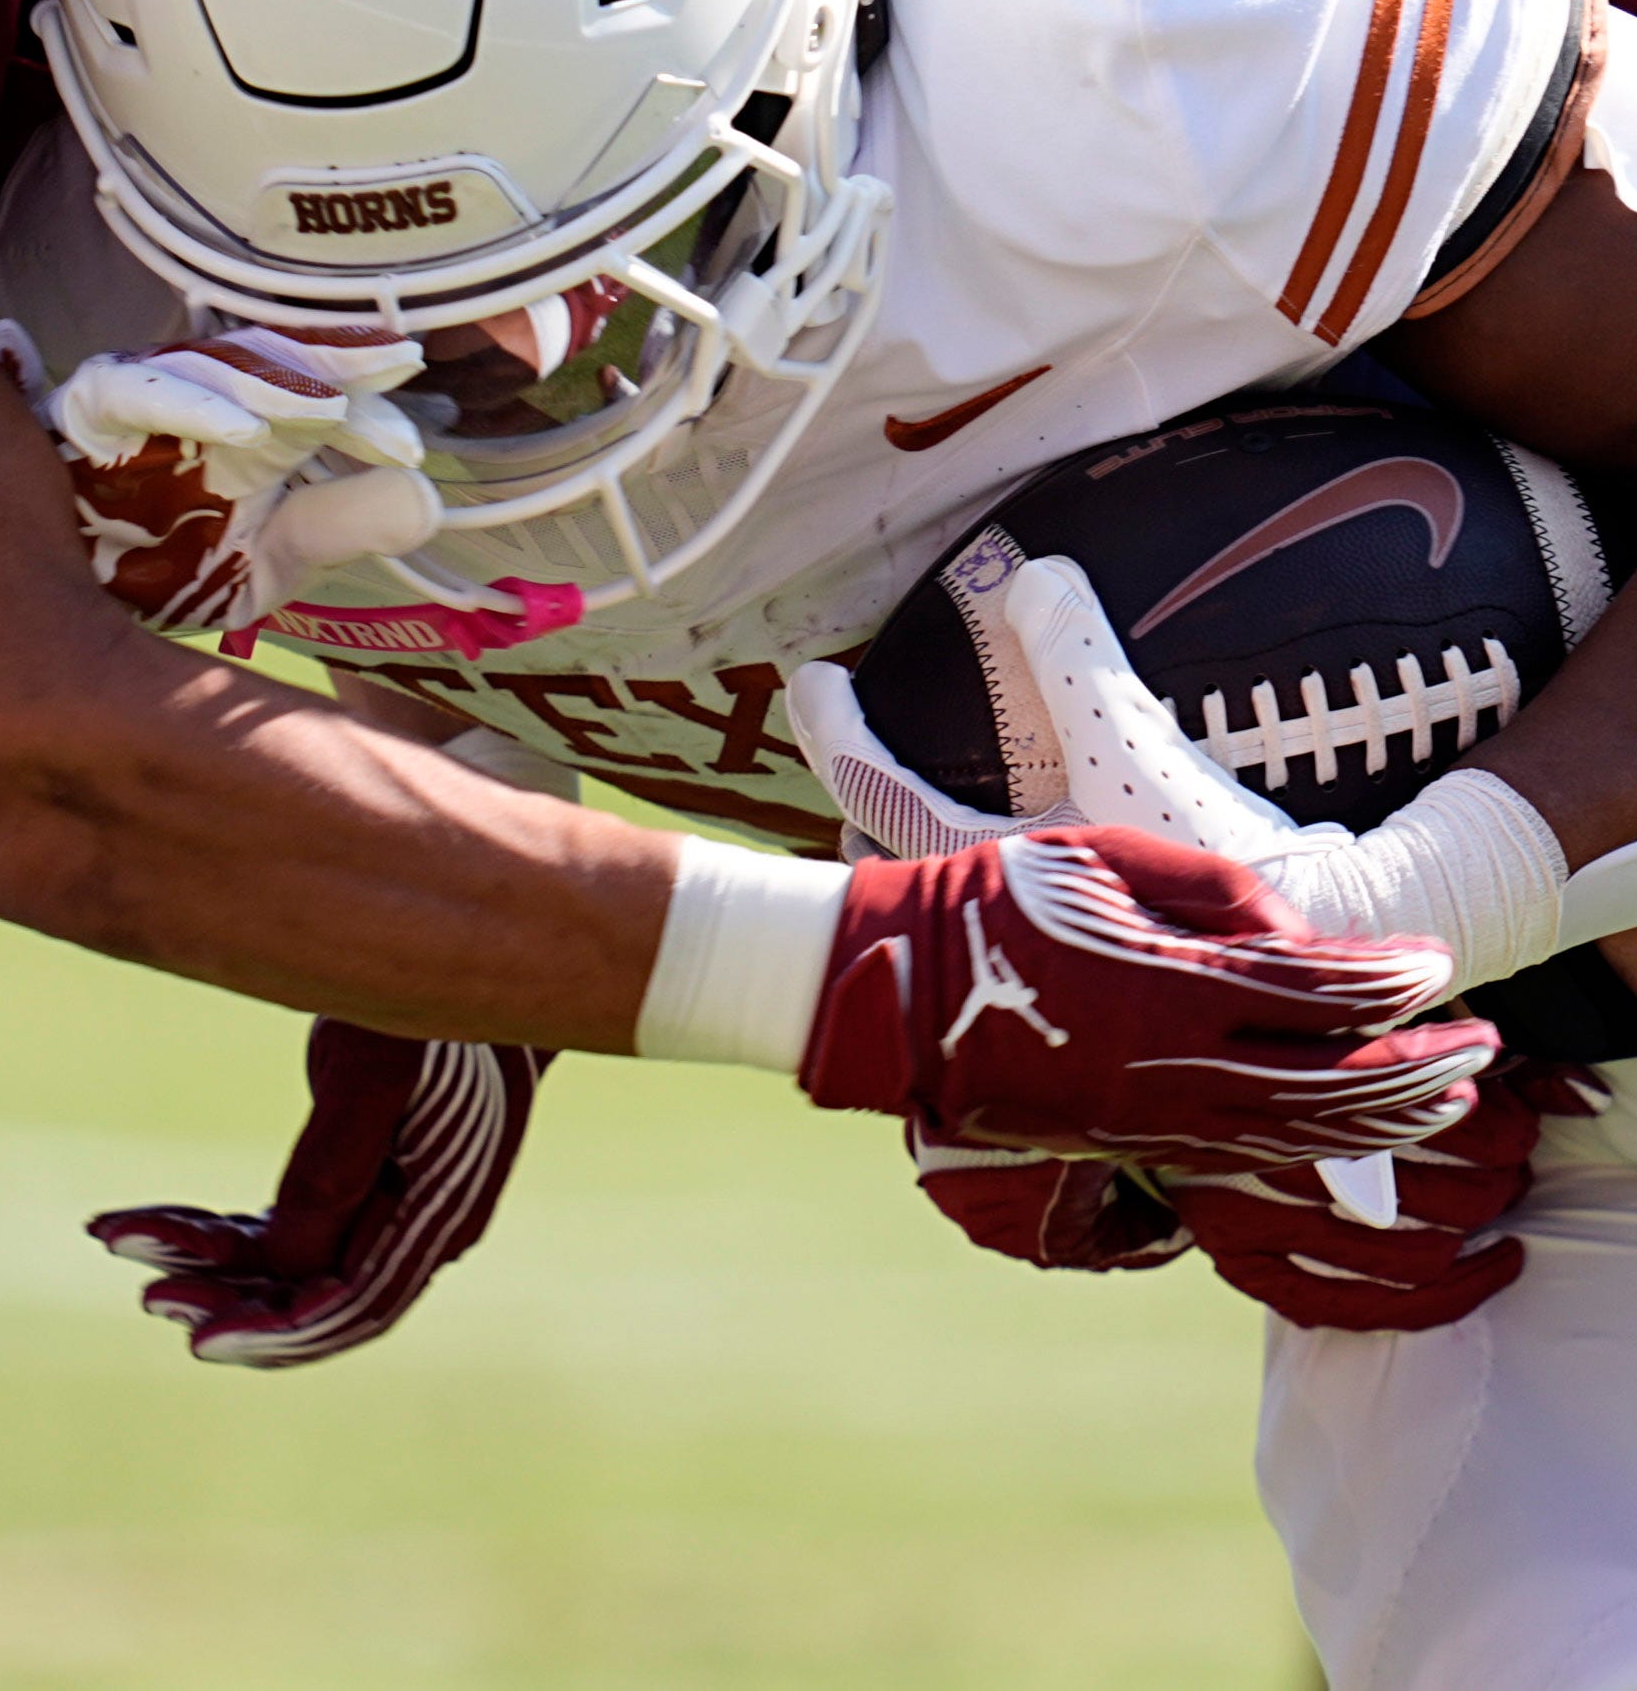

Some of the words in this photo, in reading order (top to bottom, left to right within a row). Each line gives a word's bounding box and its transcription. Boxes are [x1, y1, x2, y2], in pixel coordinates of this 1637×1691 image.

[288, 181, 458, 235] HORNS
[270, 608, 447, 649] NXTRND
[317, 640, 873, 776] TEX
